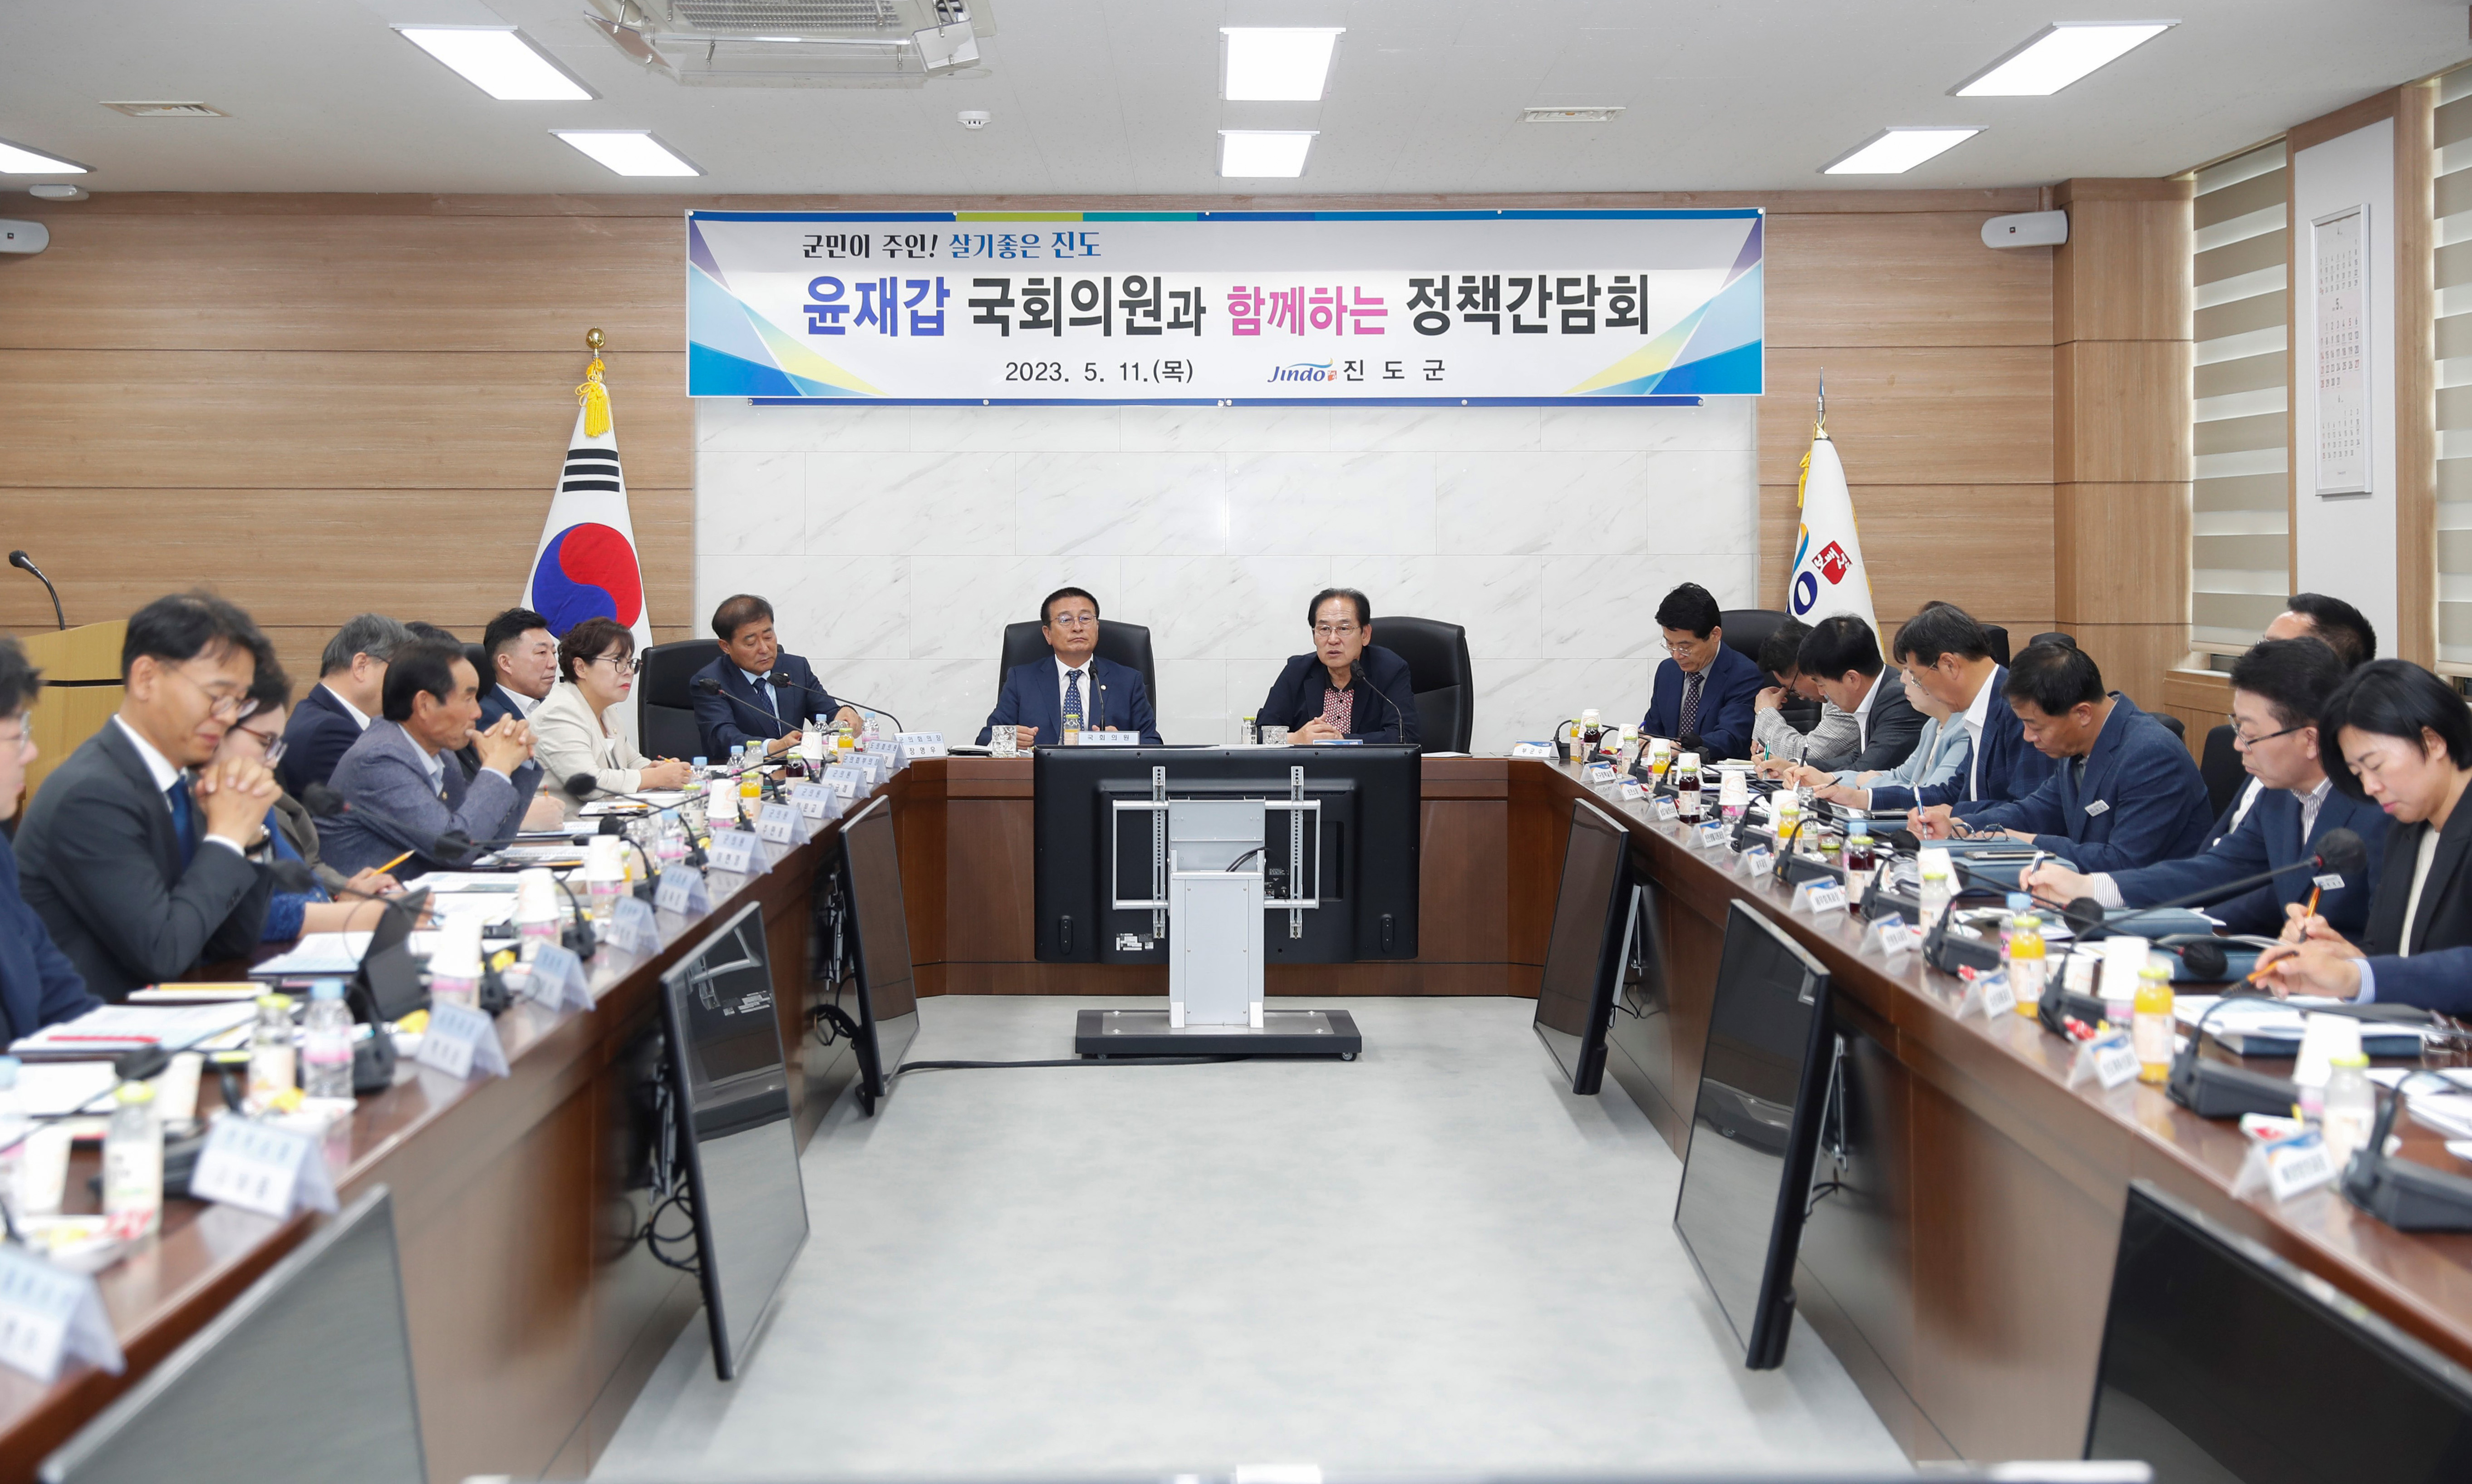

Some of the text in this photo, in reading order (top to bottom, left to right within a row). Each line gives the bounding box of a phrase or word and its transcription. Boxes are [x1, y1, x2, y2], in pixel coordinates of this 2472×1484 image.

[803, 231, 1101, 259] 군민이 주인! 살기좋은 진도
[803, 275, 1648, 337] 윤재갑 국회의원과 함께하는 정책간담회
[1006, 359, 1193, 383] 2023. 5. 11.(목)
